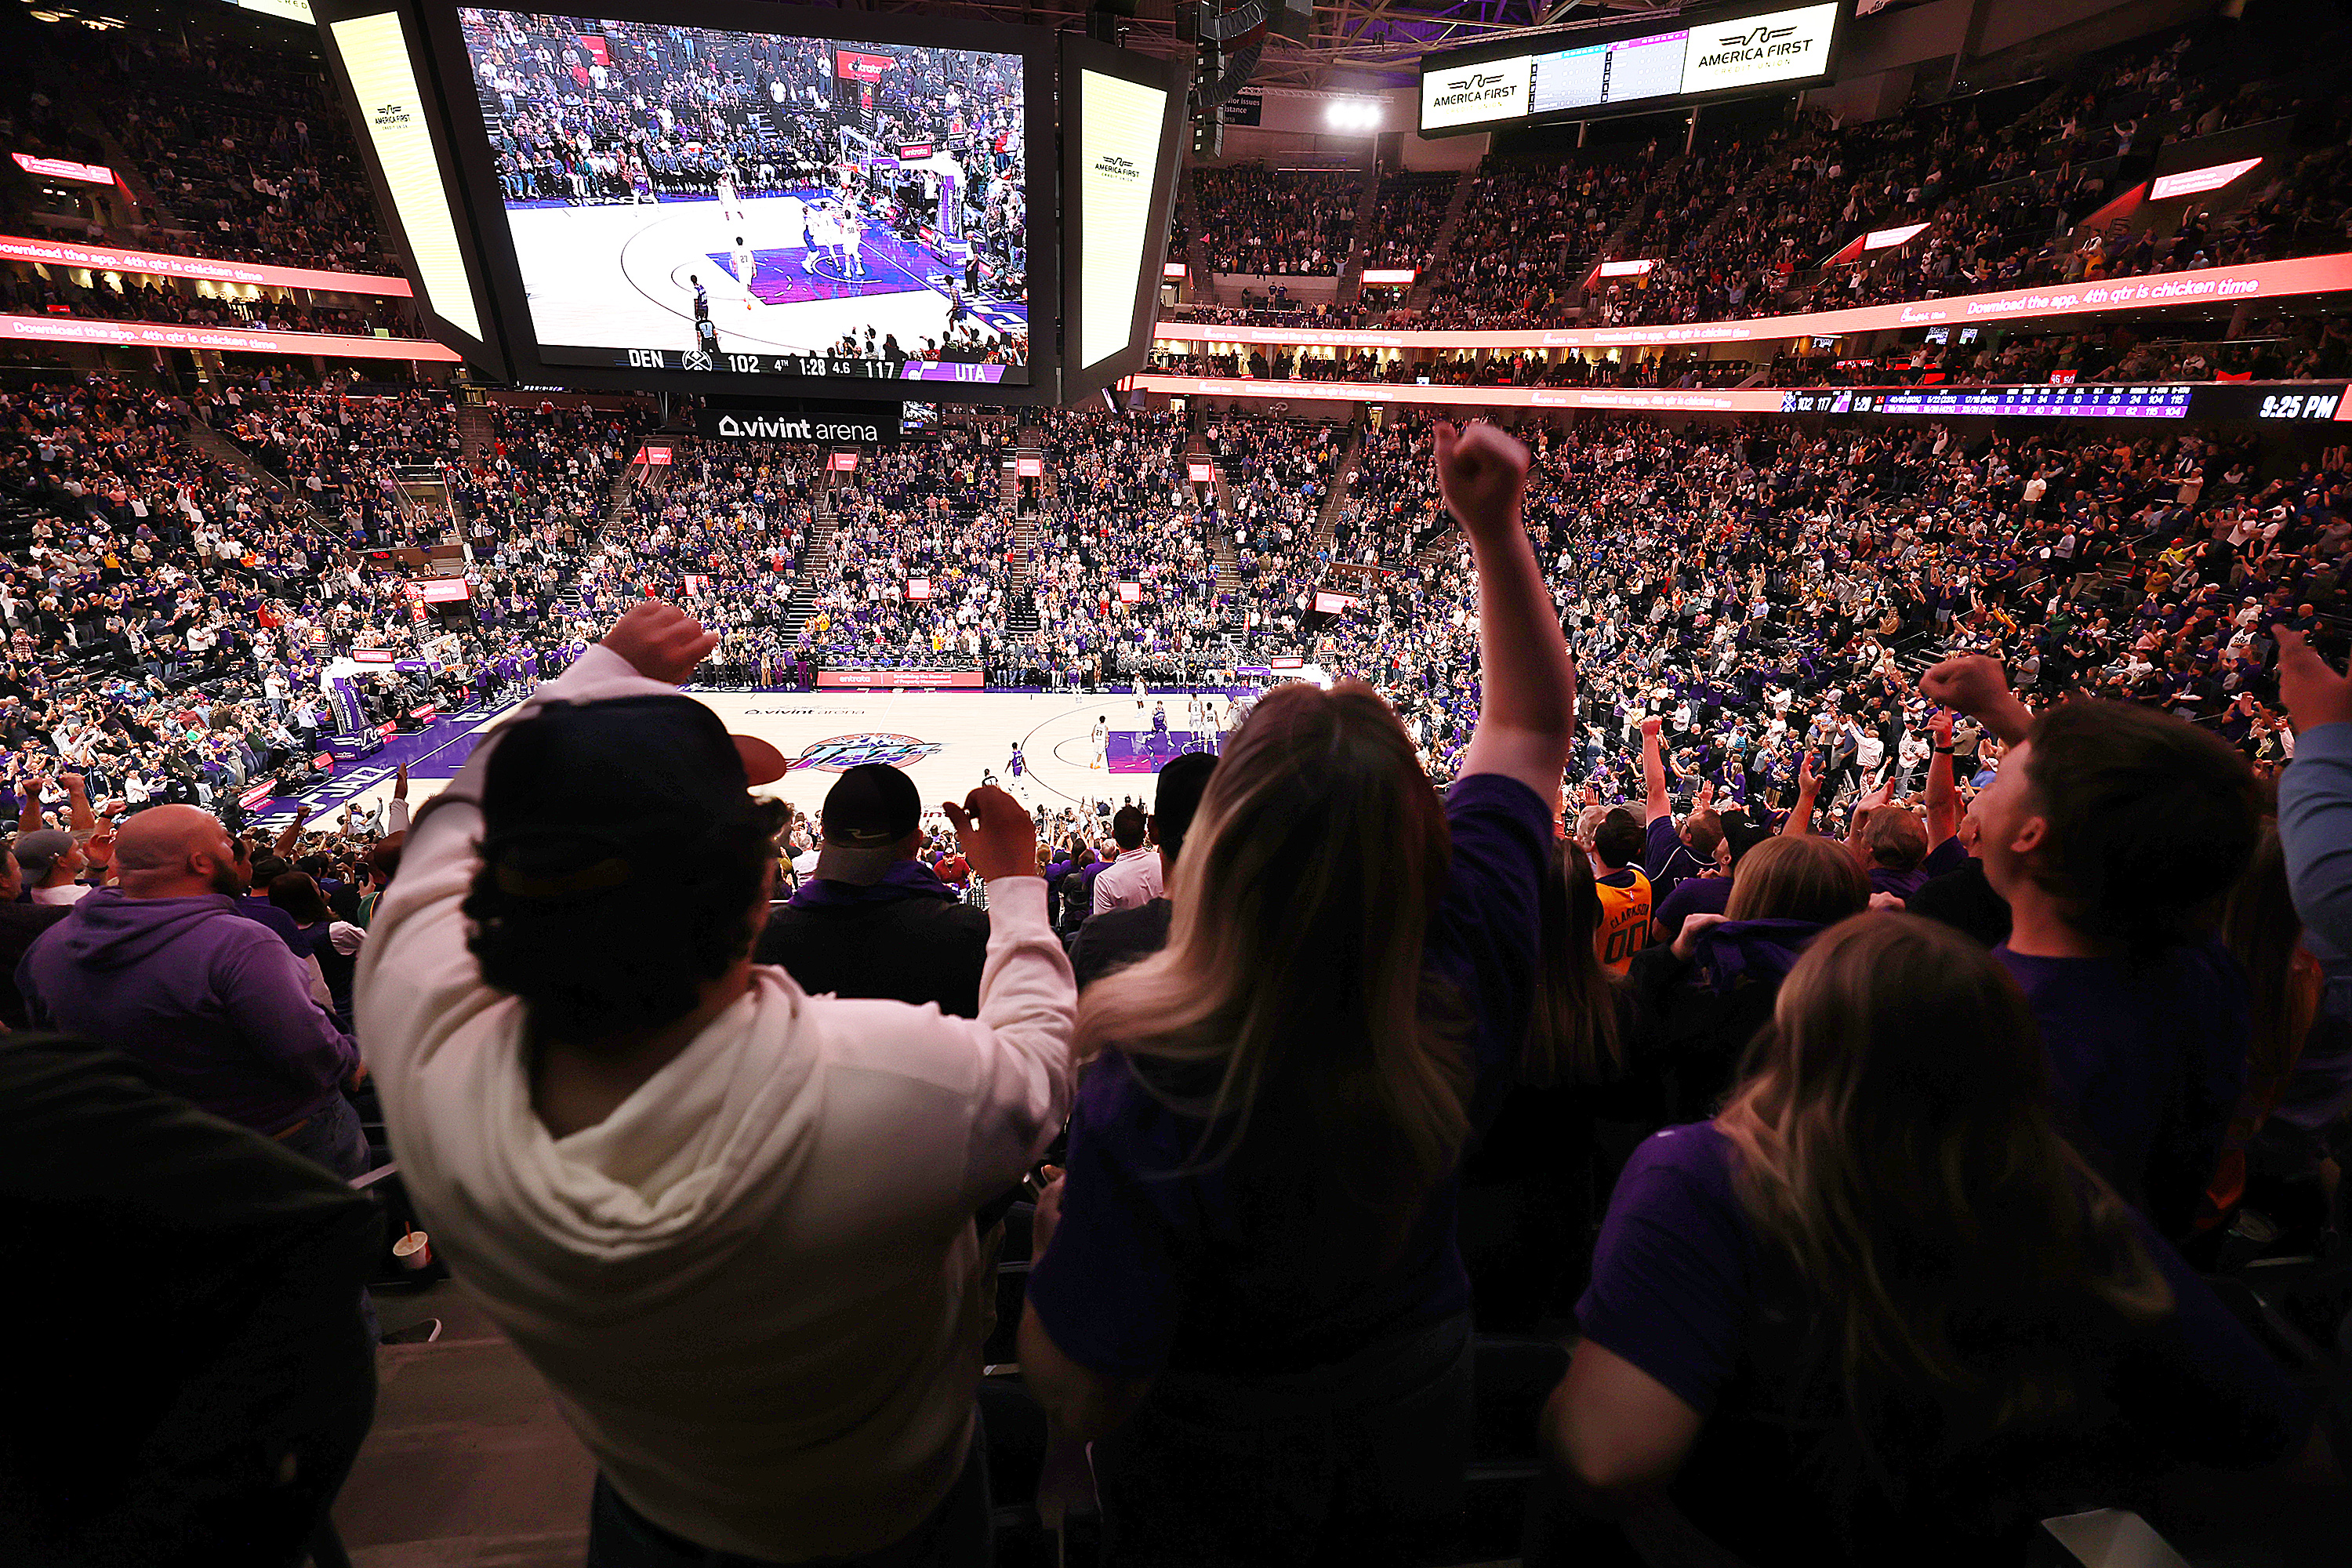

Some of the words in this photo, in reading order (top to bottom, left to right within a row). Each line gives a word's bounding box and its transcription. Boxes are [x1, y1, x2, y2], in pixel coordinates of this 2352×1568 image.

[1699, 48, 1762, 67] AMERICA
[1768, 39, 1813, 57] FIRST
[1240, 96, 1261, 107] Issues
[1434, 92, 1481, 107] AMERICA
[1485, 85, 1516, 100] FIRST
[1095, 163, 1123, 173] AMERICA
[847, 226, 855, 234] 50
[0, 245, 62, 258] ownload
[64, 249, 88, 261] the
[90, 255, 121, 267] app.
[124, 256, 147, 267] 4th
[148, 260, 169, 272] qtr
[171, 260, 182, 270] is
[183, 263, 234, 278] chicken
[234, 270, 263, 283] time
[740, 253, 749, 263] 27
[1967, 296, 2024, 316] Download
[2027, 296, 2049, 309] the
[2050, 295, 2080, 313] app.
[2083, 289, 2107, 303] 4th
[2111, 288, 2135, 307] qtr
[2136, 284, 2149, 298] is
[2151, 280, 2216, 300] chicken
[2218, 278, 2259, 297] time
[12, 321, 82, 338] Download
[84, 327, 107, 337] the
[109, 331, 139, 343] app.
[142, 331, 164, 340] 4th
[165, 332, 185, 346] qtr
[187, 332, 198, 343] is
[199, 332, 248, 347] chicken
[249, 339, 276, 350] time
[628, 346, 666, 368] DEN
[728, 352, 761, 373] 102
[774, 359, 789, 372] 4TH
[799, 355, 827, 376] 1:28
[832, 361, 851, 374] 4.6
[865, 361, 895, 379] 117
[954, 363, 988, 383] UTA
[1797, 397, 1814, 411] 102
[1816, 396, 1833, 412] 117
[2006, 395, 2015, 404] 10
[2020, 395, 2031, 404] 24
[2037, 395, 2048, 404] 34
[2054, 395, 2065, 404] 21
[2073, 395, 2082, 404] 10
[2092, 395, 2100, 404] 3
[2107, 395, 2121, 405] 20
[2129, 395, 2142, 405] 24
[2148, 394, 2165, 405] 104
[2170, 394, 2185, 405] 115
[2260, 396, 2305, 417] 9:25
[2300, 396, 2338, 419] PM
[2034, 406, 2045, 415] 40
[2070, 406, 2079, 415] 10
[2165, 407, 2181, 416] 104
[815, 423, 878, 441] arena
[423, 586, 457, 596] ntrata
[839, 673, 871, 684] entrata
[1610, 903, 1650, 930] CLARKSON
[1604, 919, 1648, 965] 00
